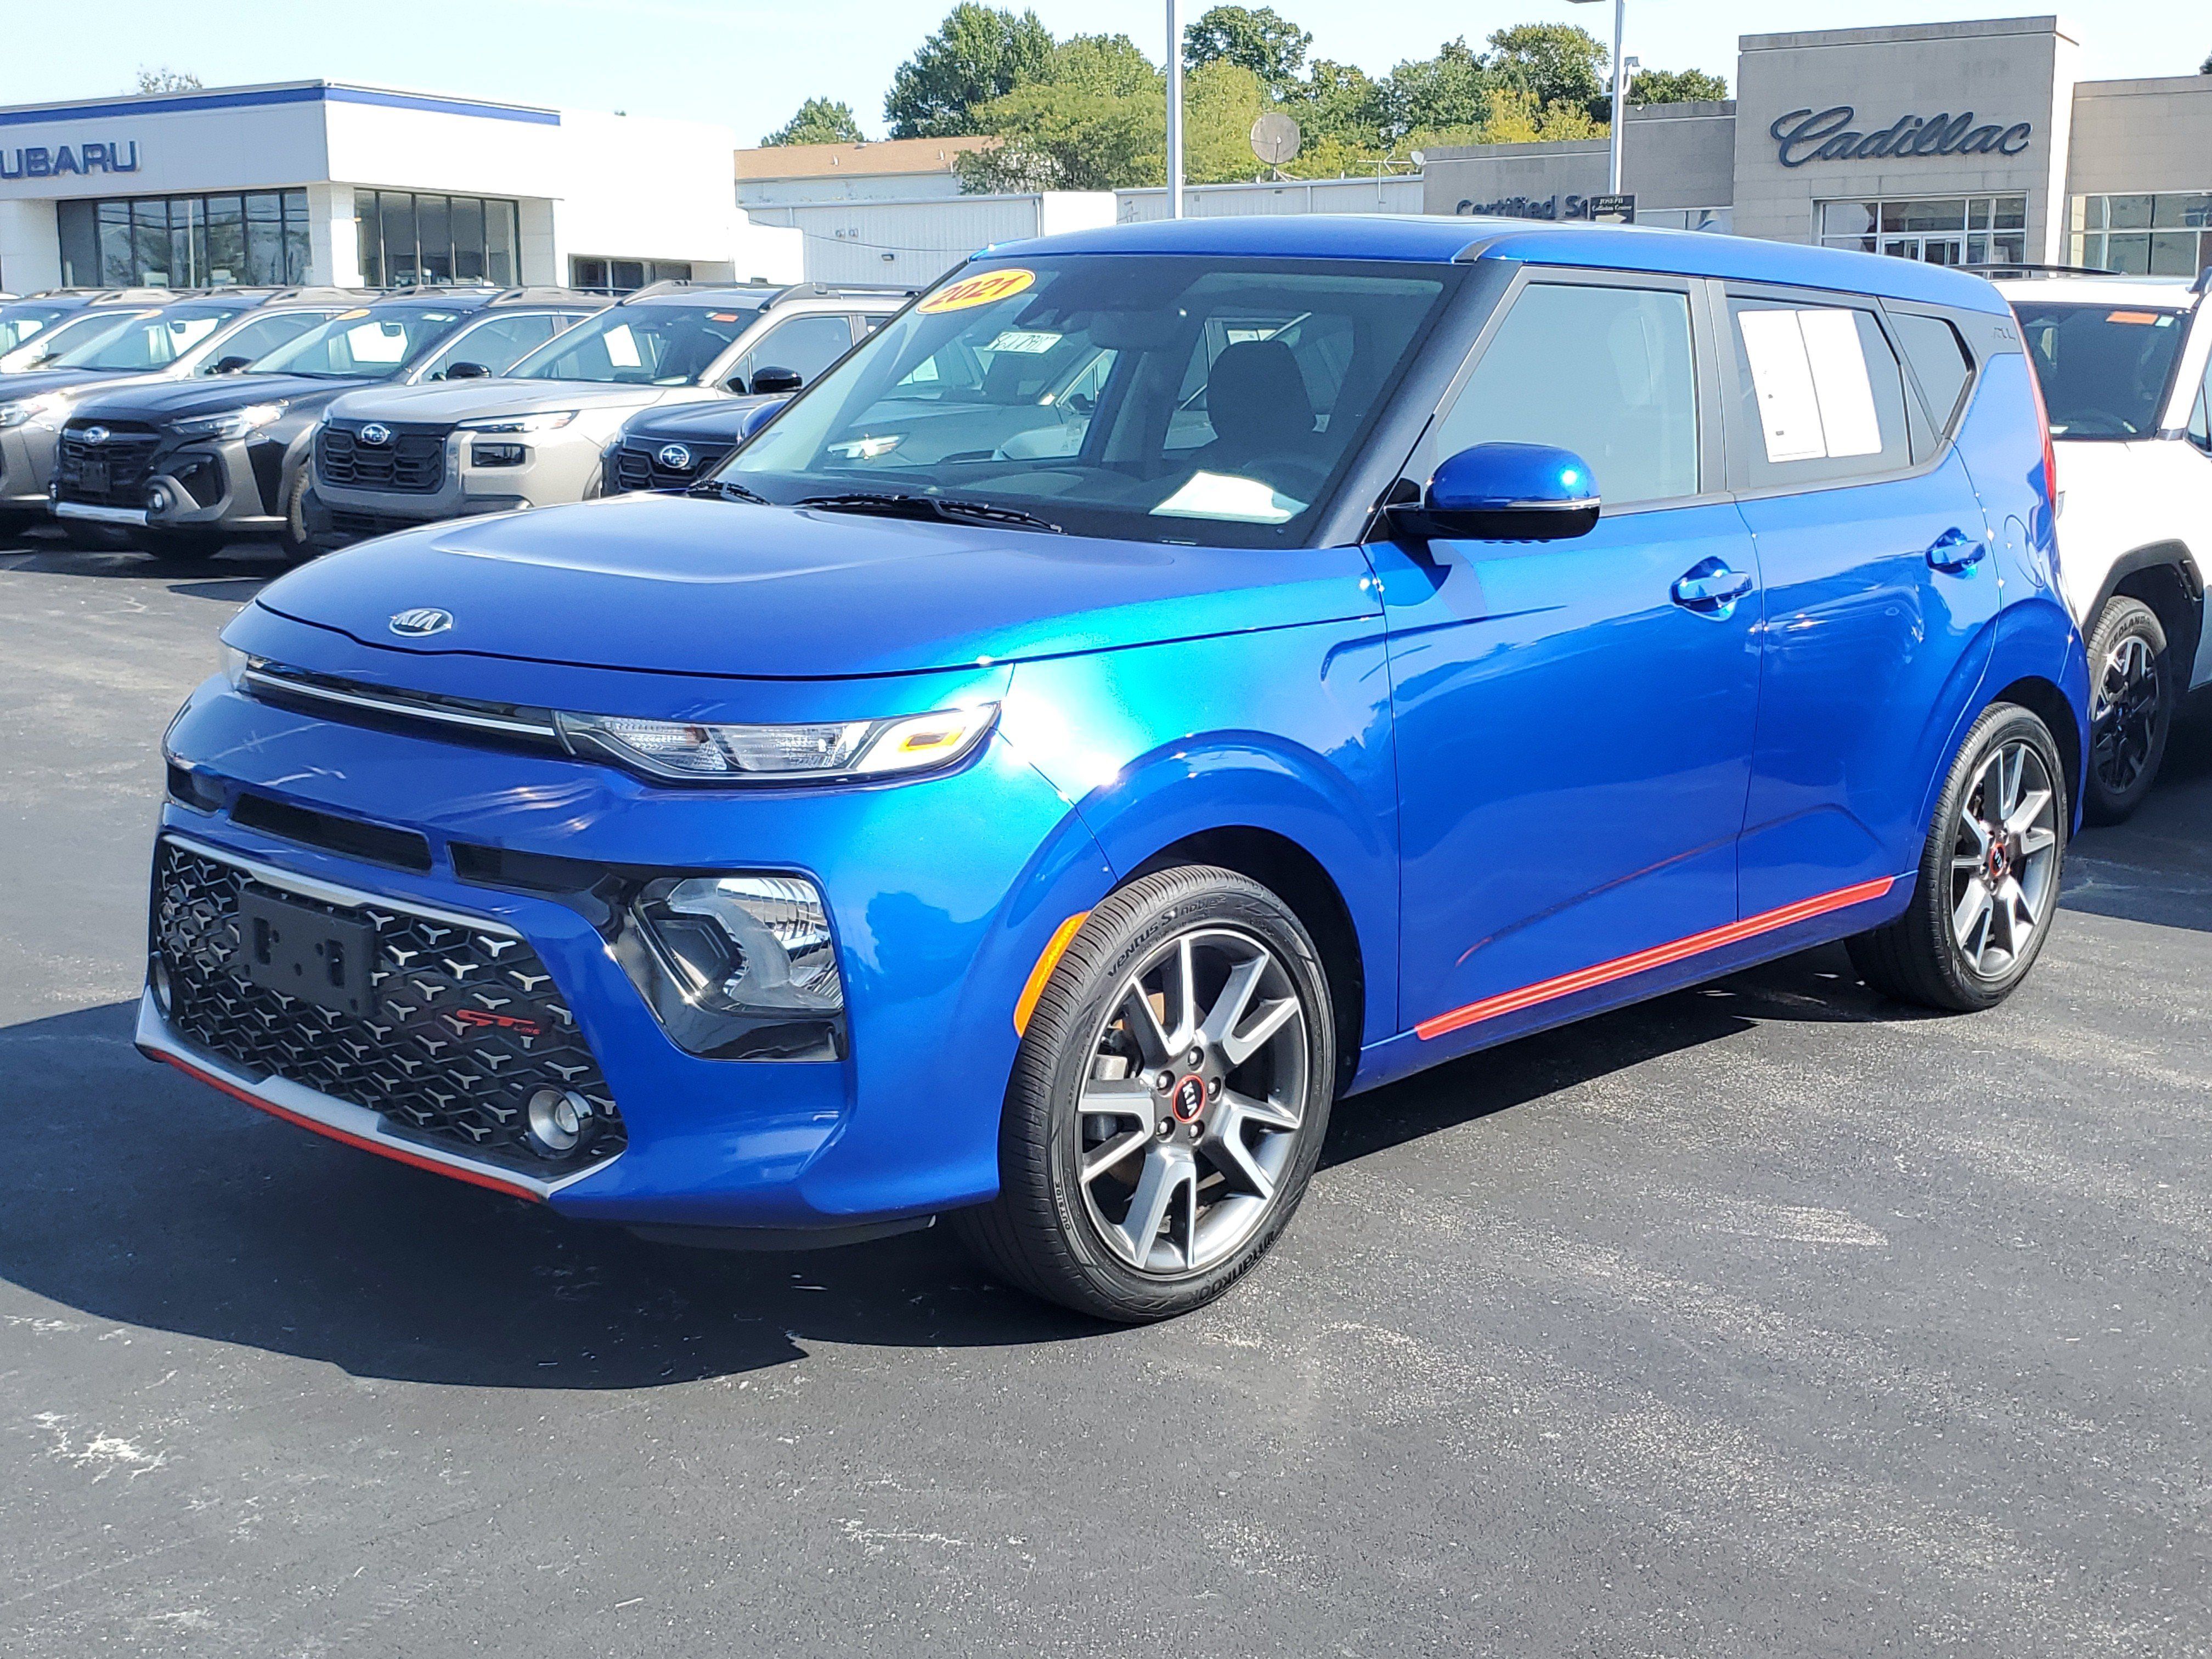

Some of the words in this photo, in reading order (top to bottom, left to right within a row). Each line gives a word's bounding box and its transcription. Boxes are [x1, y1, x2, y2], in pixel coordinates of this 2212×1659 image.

[1770, 106, 2031, 167] Cadillac
[921, 275, 1025, 309] 2021
[456, 1008, 535, 1027] GT
[1182, 1081, 1198, 1118] KIA
[1054, 1181, 1071, 1231] OUTSIDE
